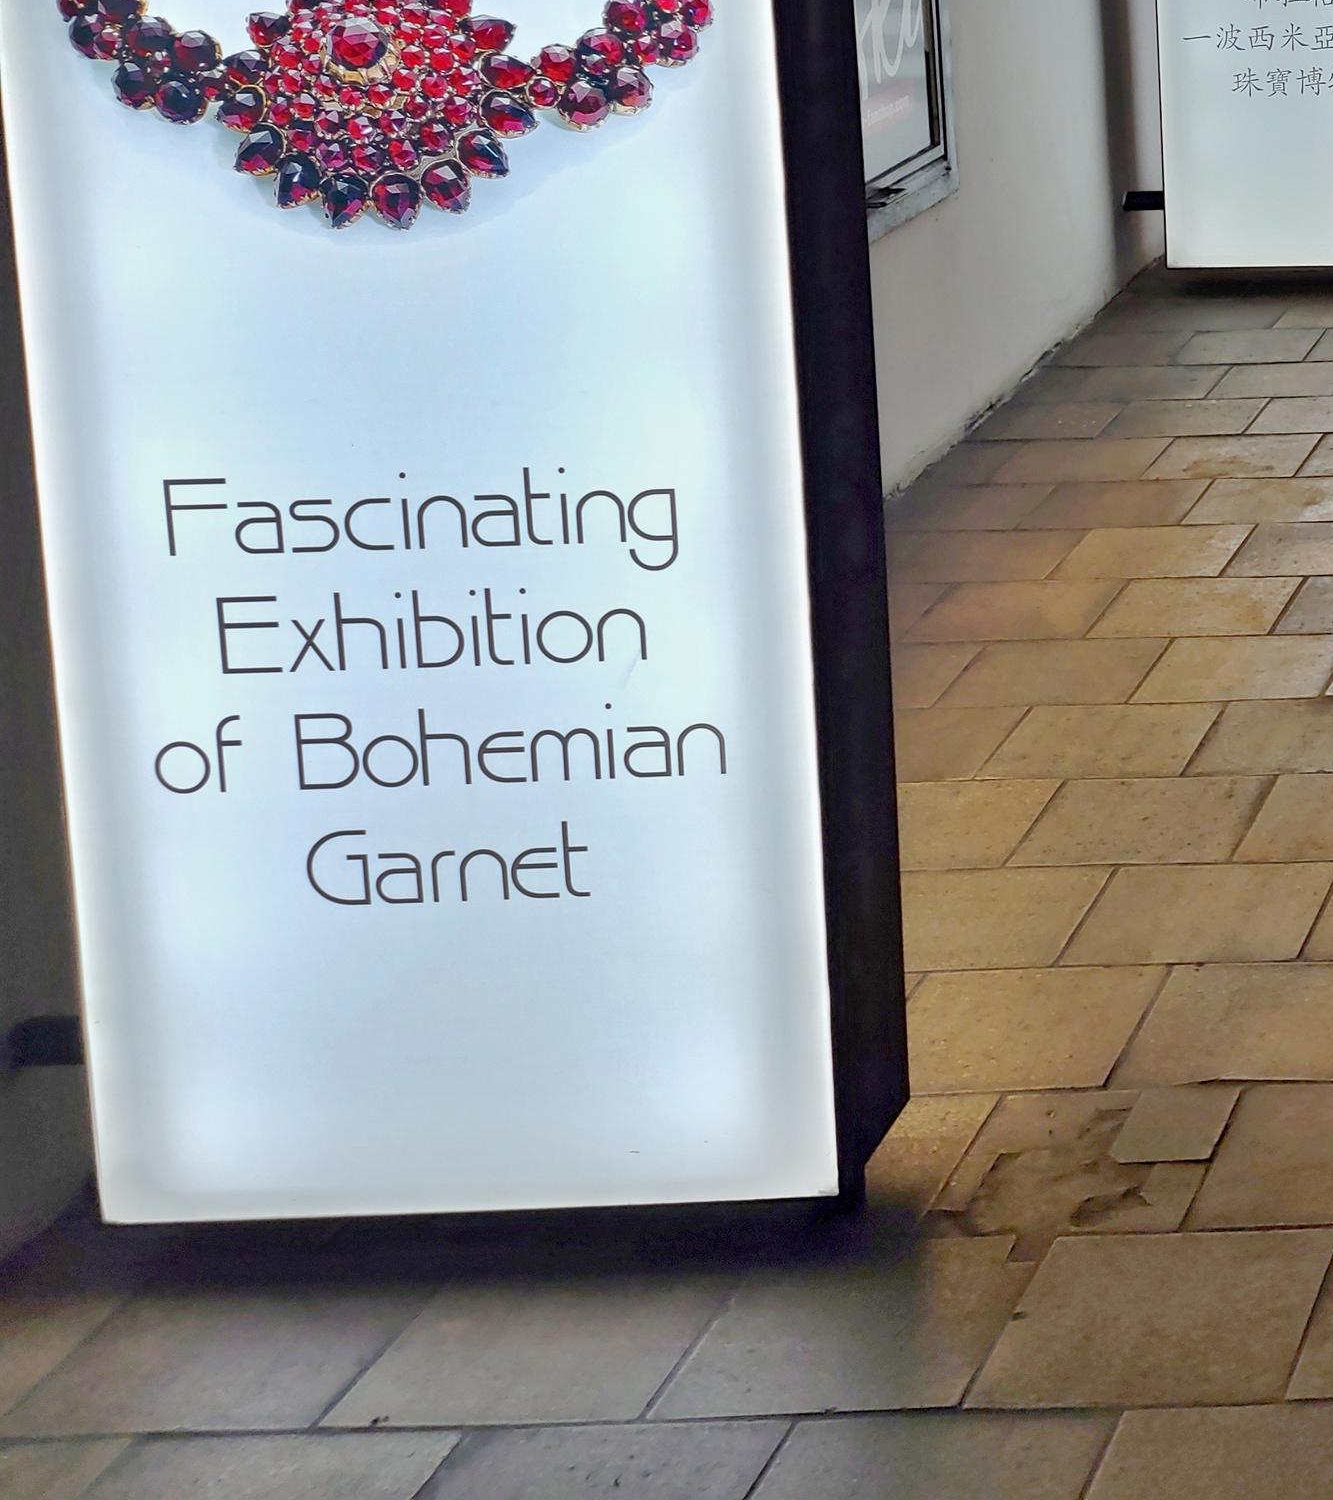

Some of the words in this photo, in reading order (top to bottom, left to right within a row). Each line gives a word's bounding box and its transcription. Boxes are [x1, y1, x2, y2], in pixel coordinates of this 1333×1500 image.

[162, 467, 678, 571] Fascinating
[215, 587, 647, 674] Exhibition
[154, 714, 243, 794] of
[294, 702, 727, 790] Bohemian
[306, 820, 591, 906] Garnet
